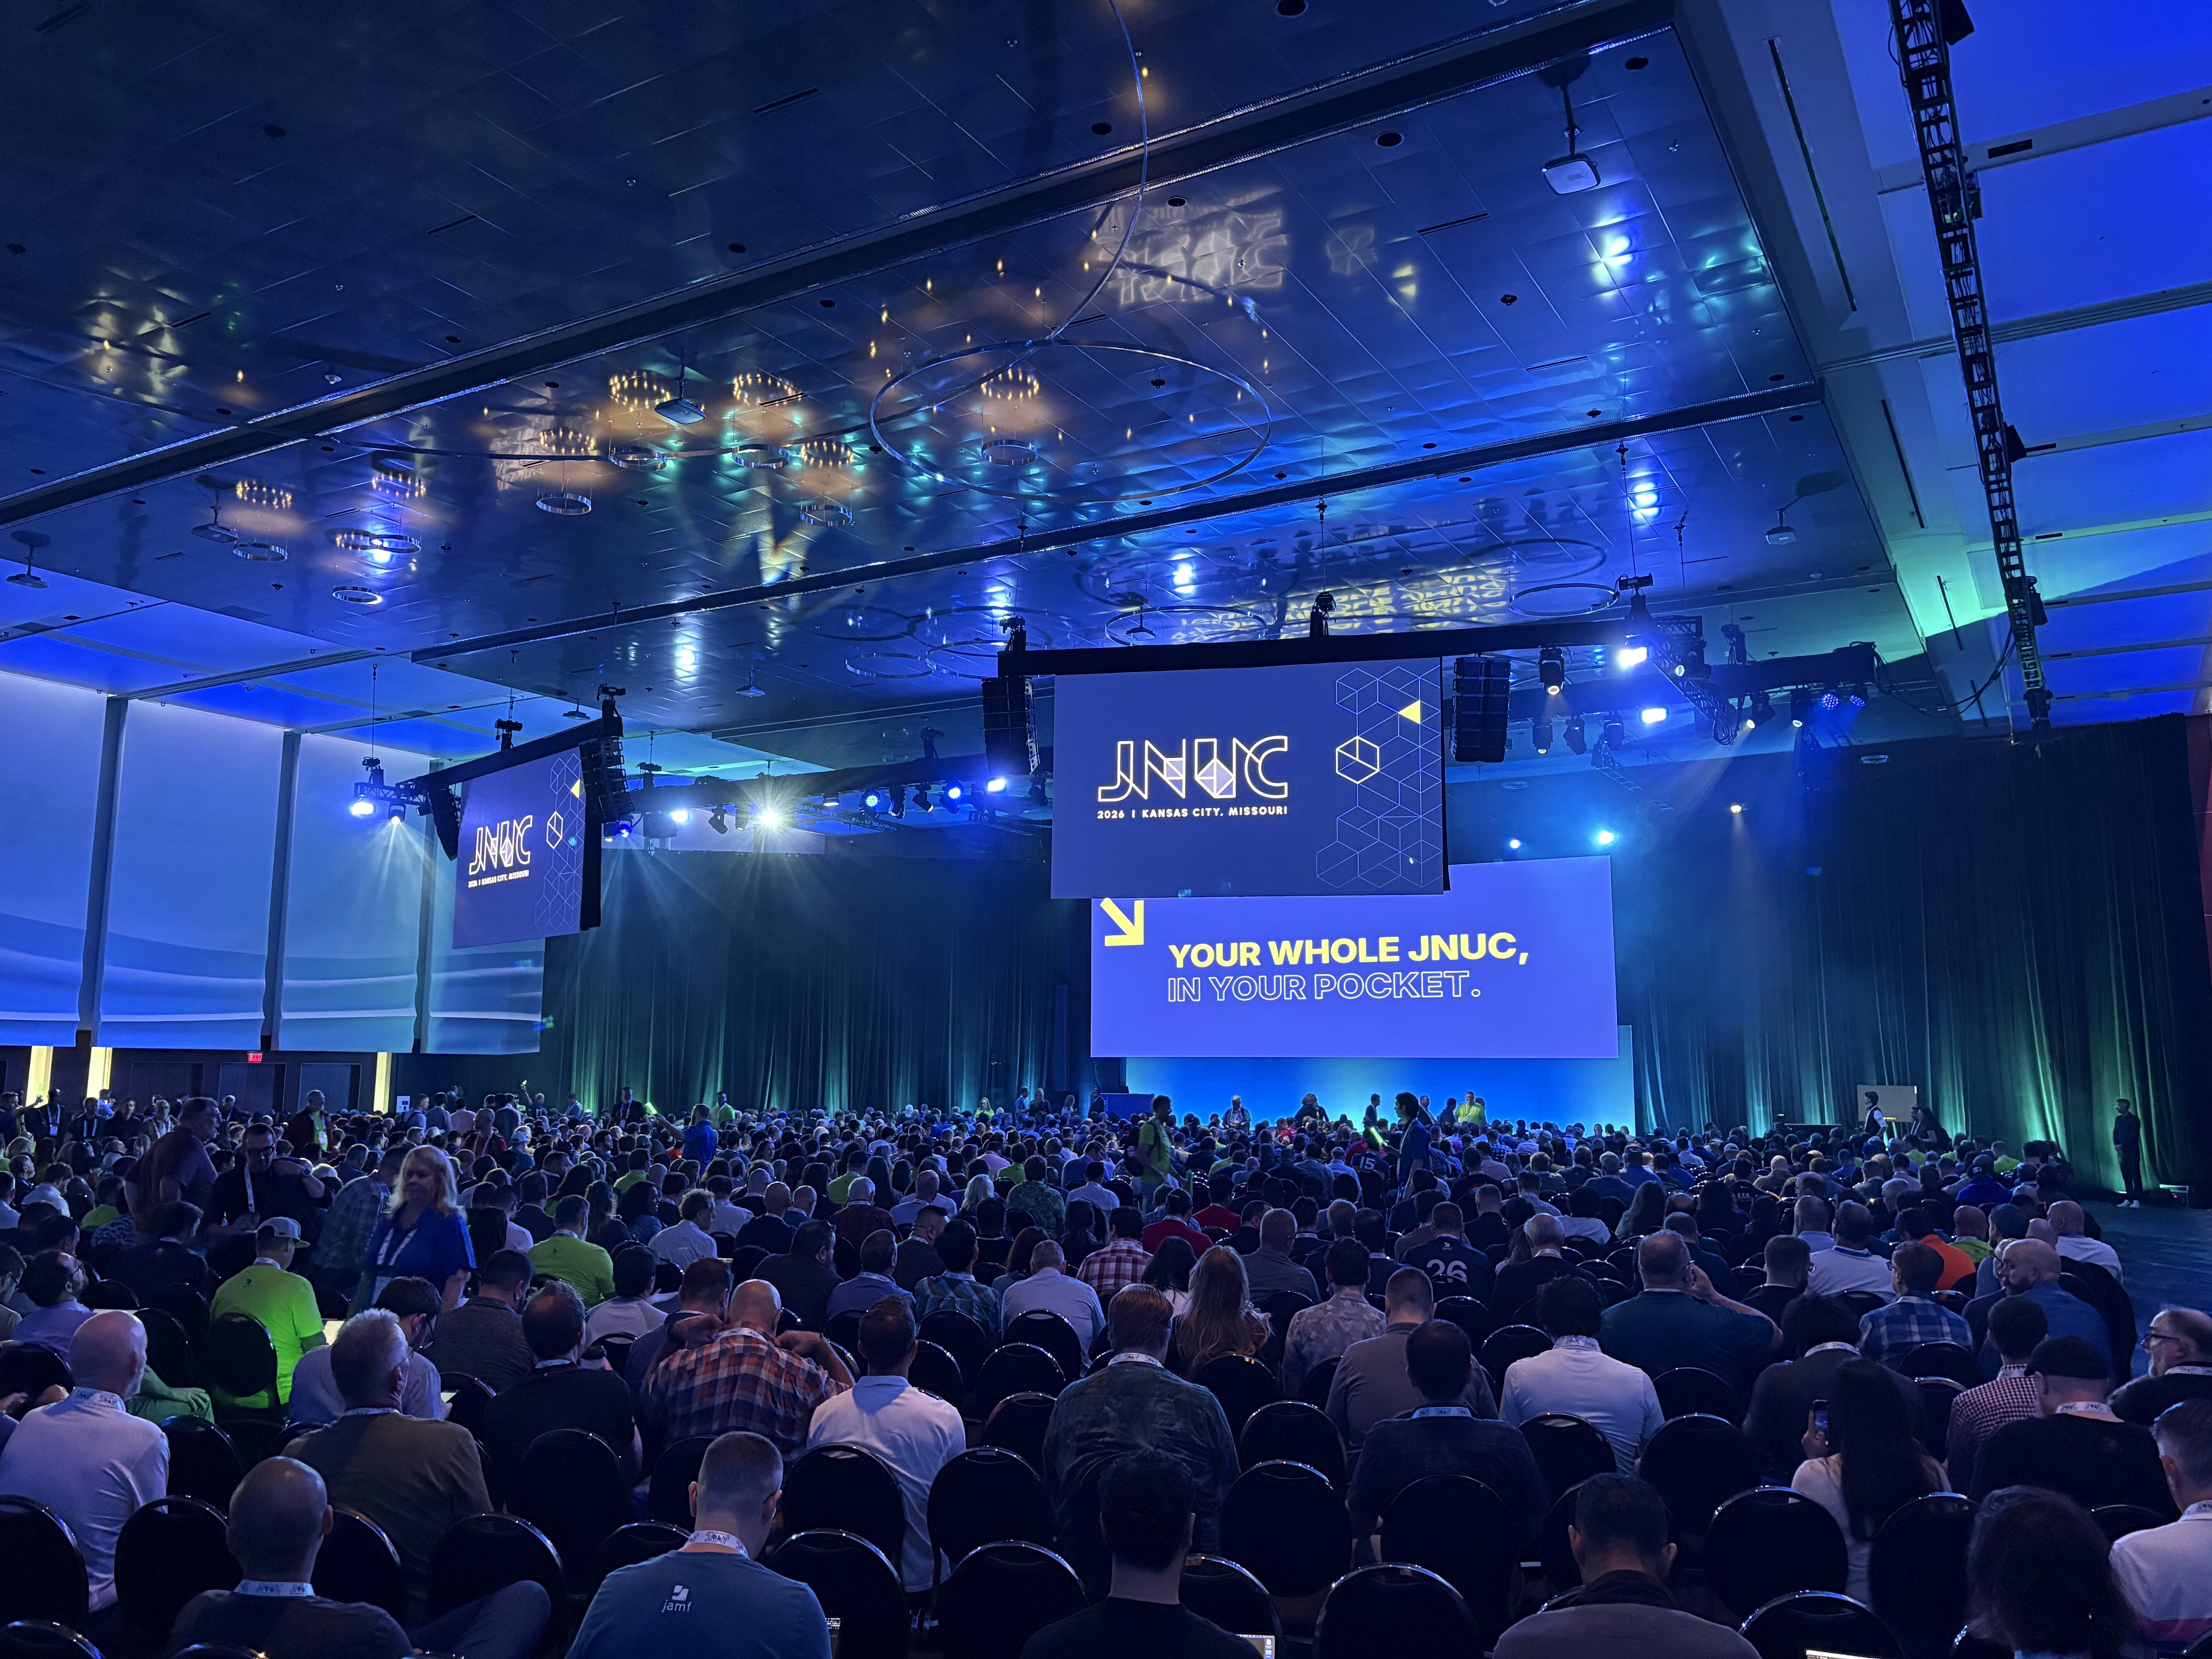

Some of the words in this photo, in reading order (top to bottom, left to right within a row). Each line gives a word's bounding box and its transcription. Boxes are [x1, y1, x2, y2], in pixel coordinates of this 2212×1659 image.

[1098, 735, 1288, 802] JNUC
[1097, 810, 1125, 819] 2026
[1142, 808, 1188, 818] KANSAS
[1192, 807, 1224, 817] CITY,
[1228, 806, 1287, 816] MISSOURI
[469, 815, 533, 875] JNUC
[481, 876, 497, 885] KANSAS
[508, 870, 529, 880] MISSOURI
[1168, 942, 1261, 968] YOUR
[1268, 936, 1400, 965] WHOLE
[1408, 932, 1528, 965] JNUC,
[1168, 977, 1200, 1002] IN
[1208, 974, 1307, 1001] YOUR
[1314, 970, 1481, 1000] POCKET.
[1360, 1156, 1376, 1170] 15
[1427, 1259, 1467, 1283] 26
[661, 1599, 692, 1613] jamf
